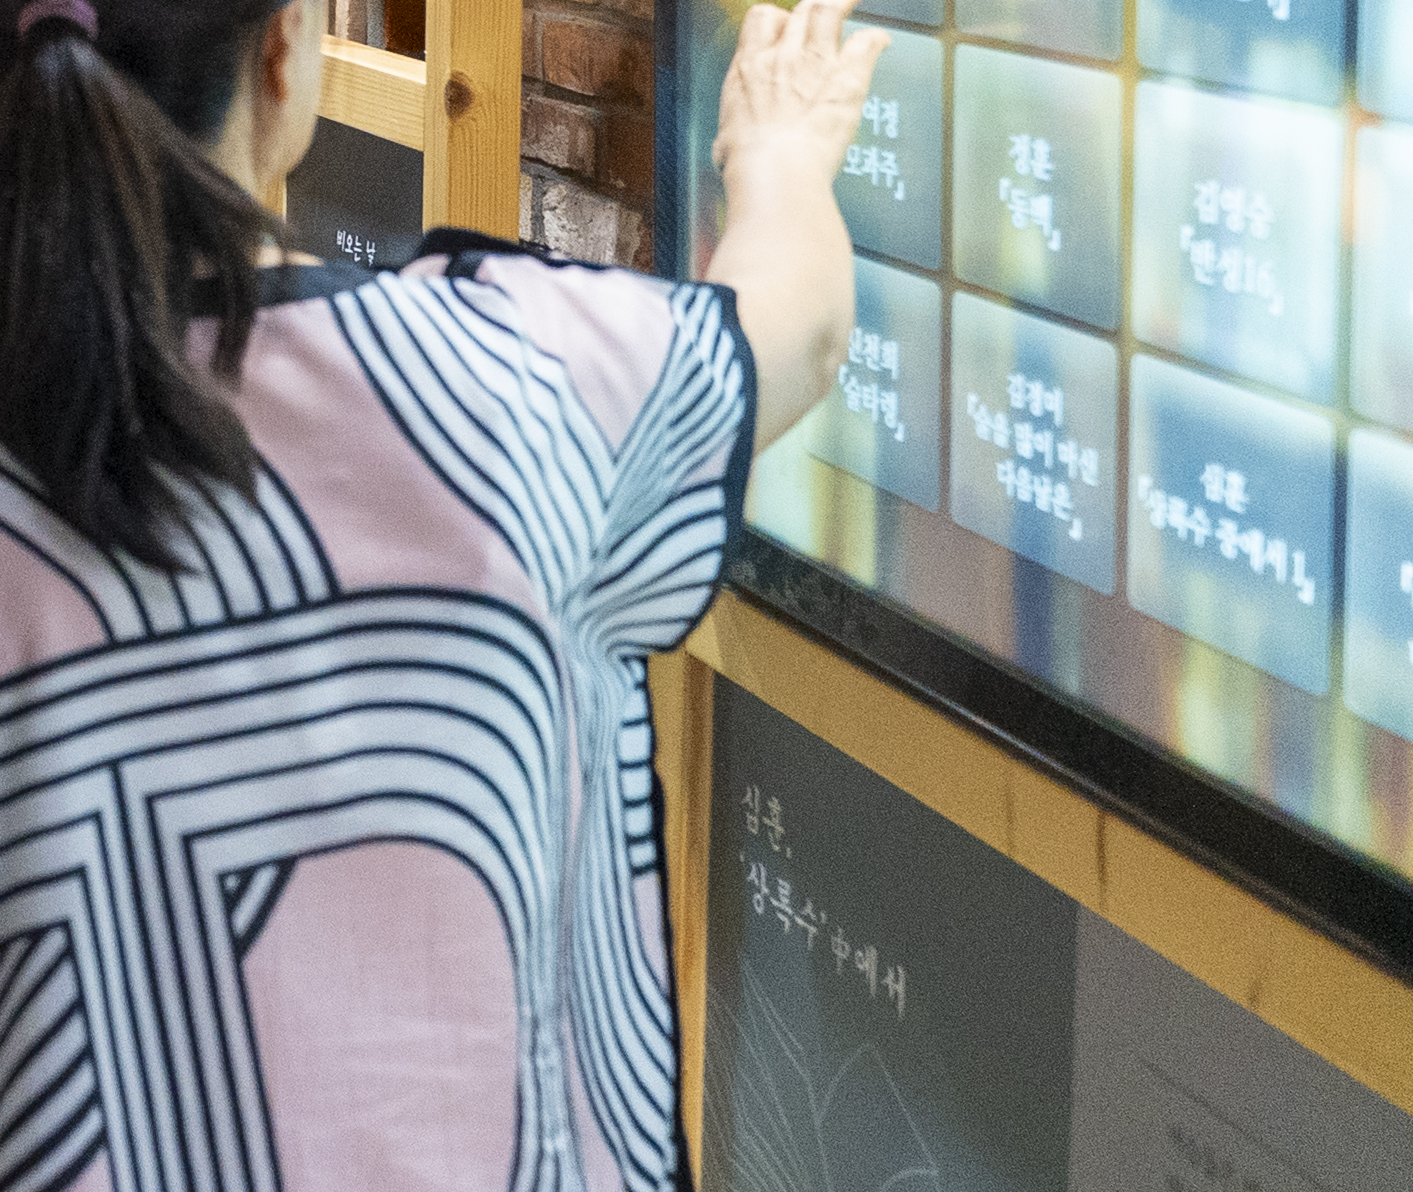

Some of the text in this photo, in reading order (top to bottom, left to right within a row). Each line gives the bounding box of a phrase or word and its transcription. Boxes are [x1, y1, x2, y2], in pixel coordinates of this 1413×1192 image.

[336, 229, 377, 267] 비오는 날
[1199, 462, 1250, 515] 심훈
